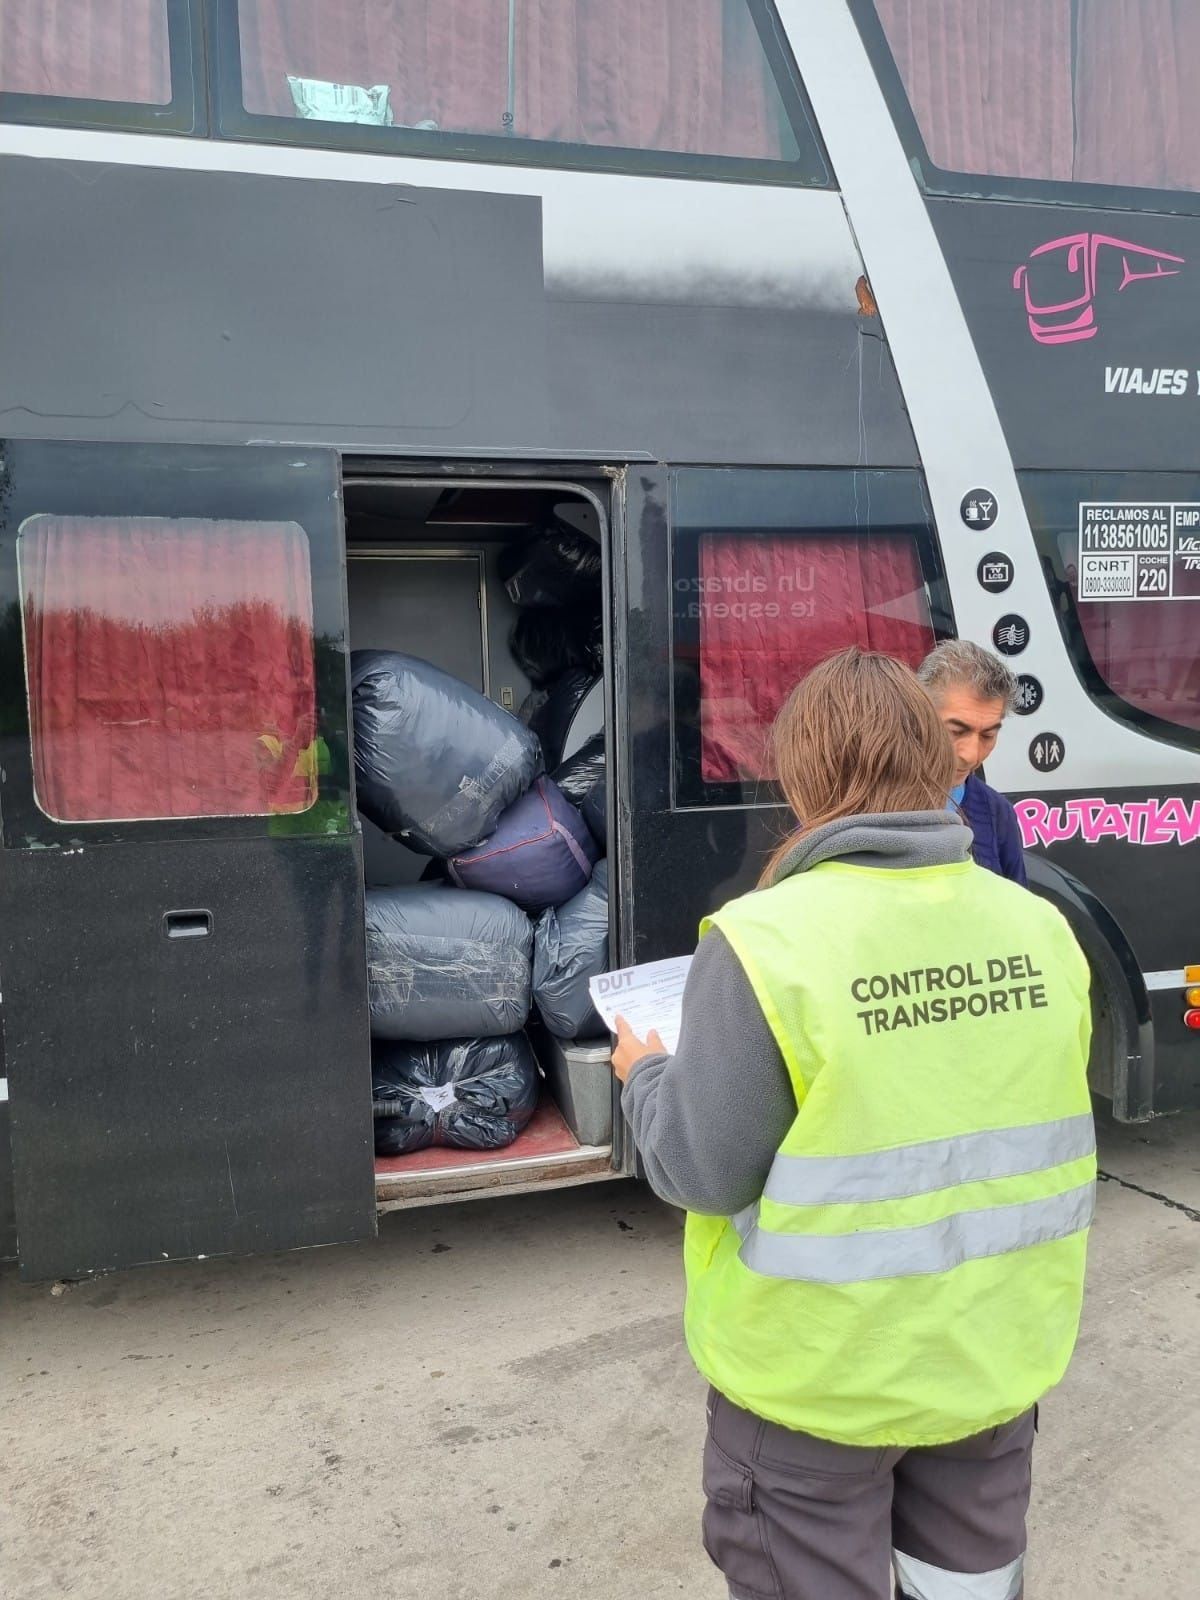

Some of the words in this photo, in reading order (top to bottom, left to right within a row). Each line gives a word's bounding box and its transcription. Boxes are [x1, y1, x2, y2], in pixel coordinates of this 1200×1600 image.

[1104, 367, 1189, 395] VIAJES
[1086, 509, 1149, 521] RECLAMOS
[1152, 509, 1167, 521] AL
[1084, 524, 1168, 548] 1138561005
[1087, 560, 1129, 572] CNRT
[1139, 556, 1168, 564] COCHE
[1139, 568, 1167, 591] 220
[598, 971, 634, 994] DUT
[851, 962, 983, 1003] CONTROL
[986, 953, 1042, 983] DEL
[856, 983, 1048, 1036] TRANSPORTE
